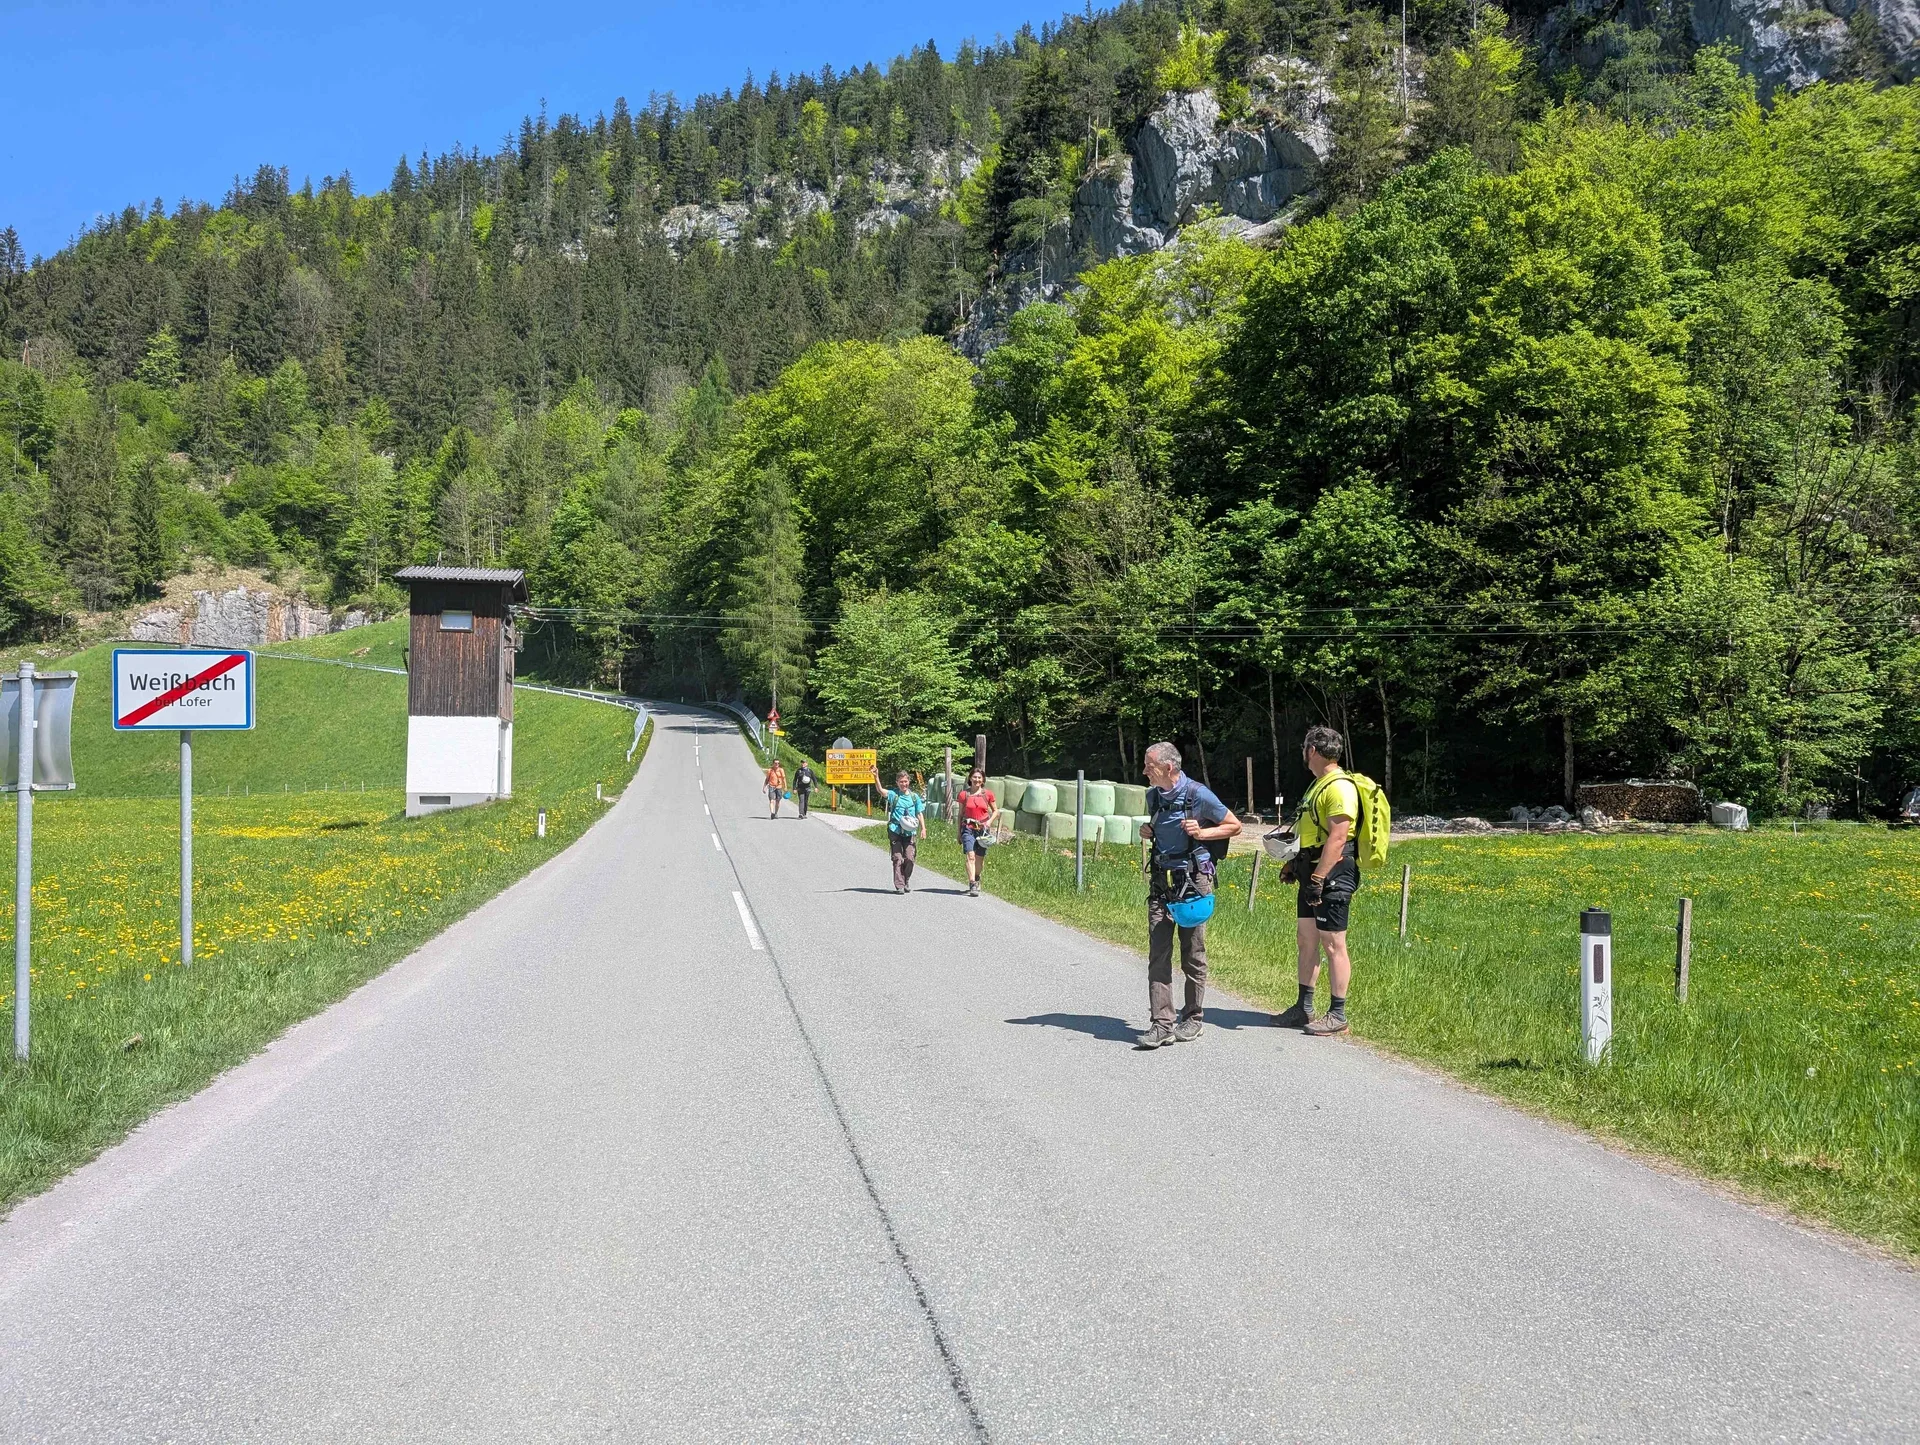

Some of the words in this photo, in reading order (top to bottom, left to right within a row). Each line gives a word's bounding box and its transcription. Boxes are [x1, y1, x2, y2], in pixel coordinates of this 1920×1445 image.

[129, 672, 235, 691] Weißbach
[155, 696, 175, 707] bei
[179, 696, 213, 707] Lofer
